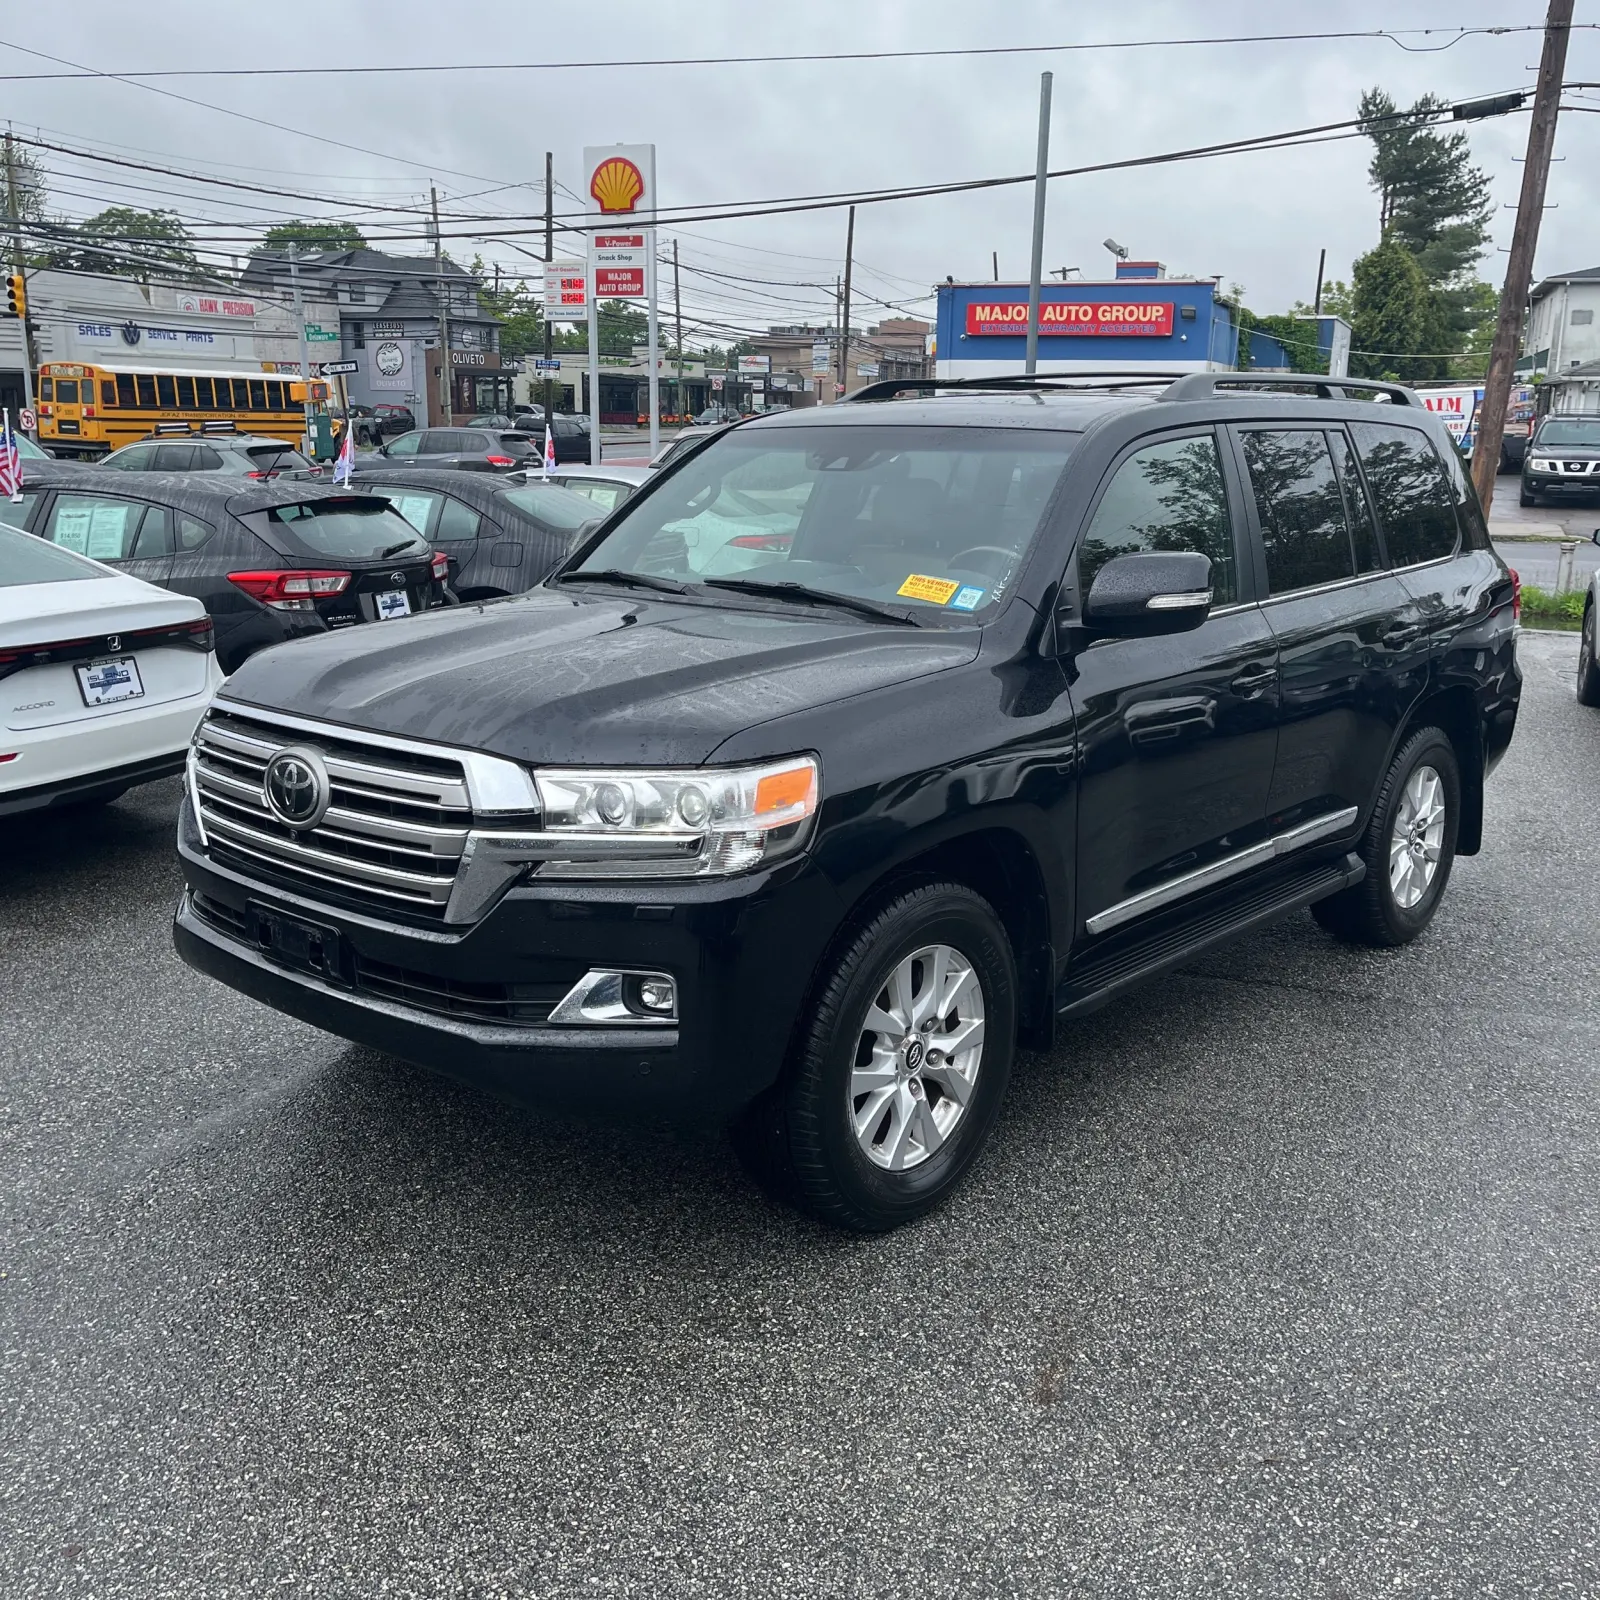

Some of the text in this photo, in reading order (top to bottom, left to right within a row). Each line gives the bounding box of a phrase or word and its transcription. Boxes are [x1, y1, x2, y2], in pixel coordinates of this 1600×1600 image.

[617, 254, 632, 262] Shop
[608, 272, 632, 280] MAJOR
[199, 298, 218, 313] HAWK
[222, 300, 254, 316] PRECISION
[976, 306, 1164, 321] MAJO AUTO GROUP
[79, 325, 111, 337] SALES
[1038, 324, 1096, 333] WARRANTY
[1100, 324, 1156, 333] ACCEPTED
[148, 330, 214, 343] SERVICE PARTS
[452, 352, 484, 365] OLIVETO
[927, 580, 954, 589] VEHICLE
[87, 670, 129, 682] ISLAND
[12, 700, 55, 713] ACCORD
